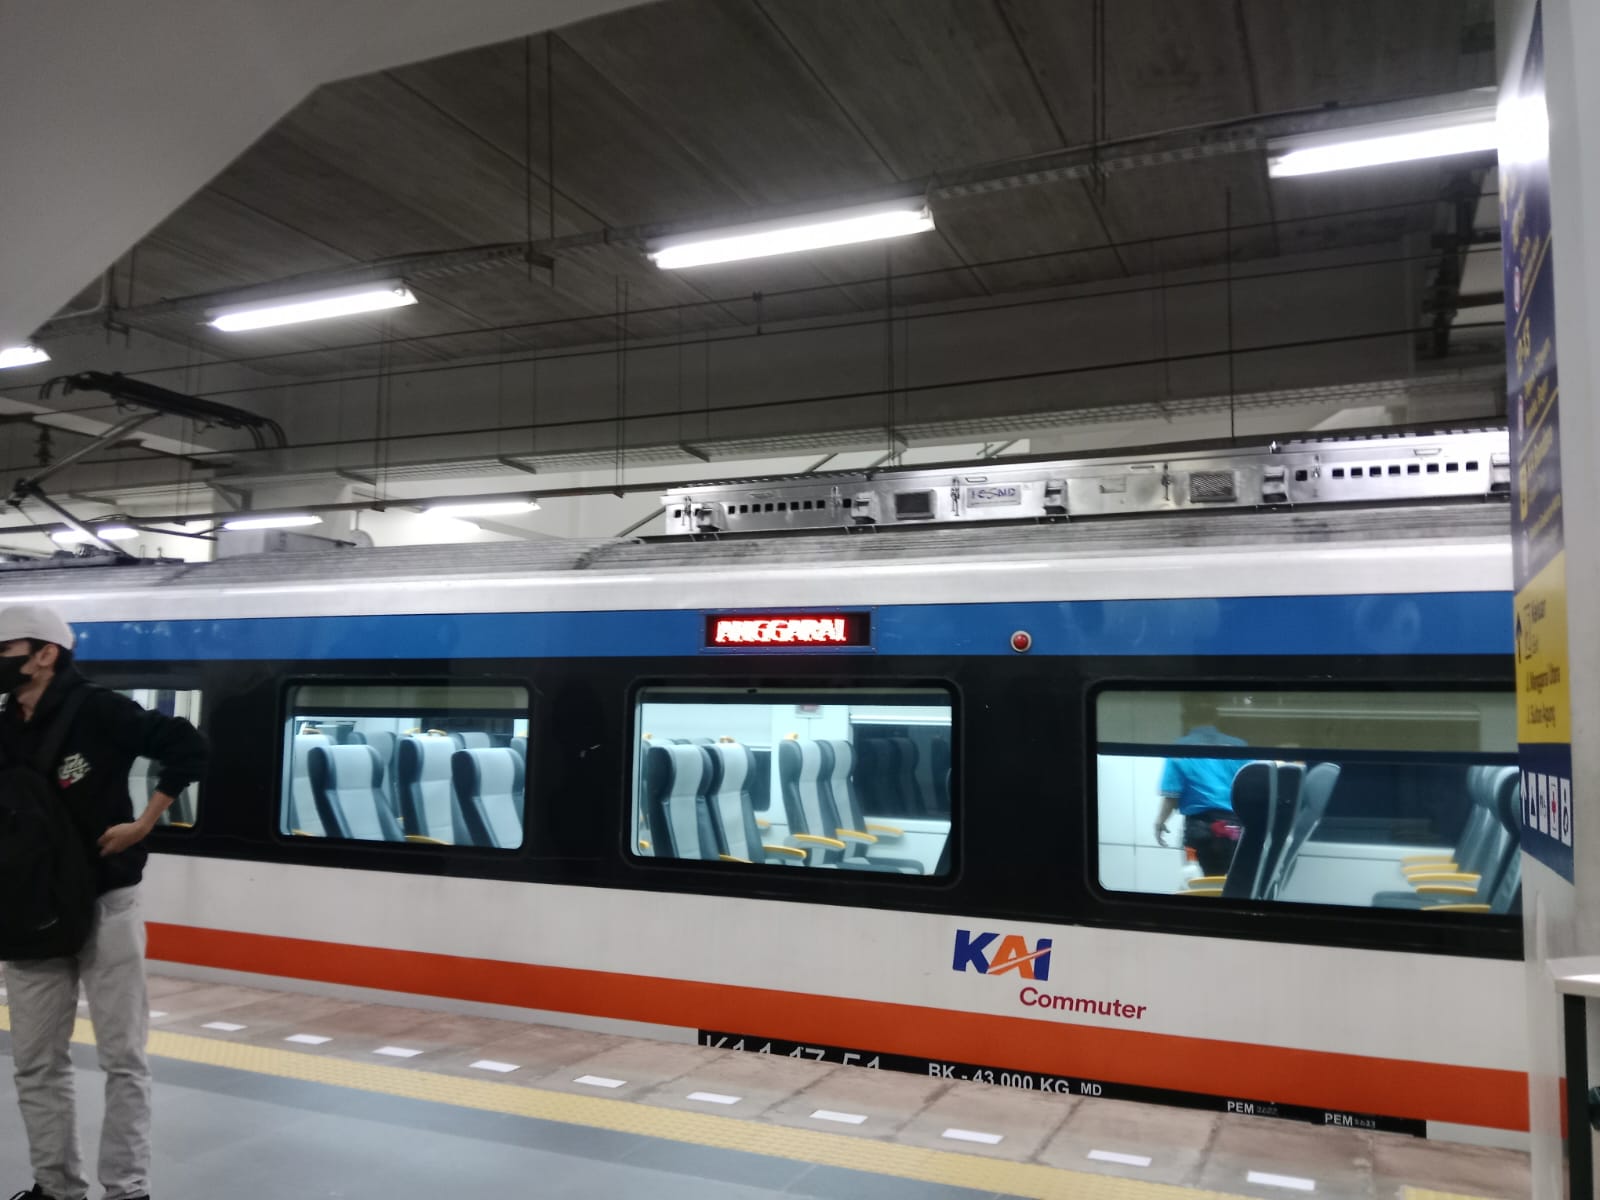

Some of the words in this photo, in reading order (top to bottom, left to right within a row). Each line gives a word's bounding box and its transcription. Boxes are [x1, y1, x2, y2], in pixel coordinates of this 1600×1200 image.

[952, 929, 1053, 981] KAI
[1019, 987, 1147, 1019] Commuter
[928, 1062, 956, 1080] BK
[1040, 1077, 1070, 1095] KG
[1081, 1082, 1103, 1097] MD
[1227, 1100, 1255, 1115] PEM
[1324, 1112, 1353, 1127] PEM
